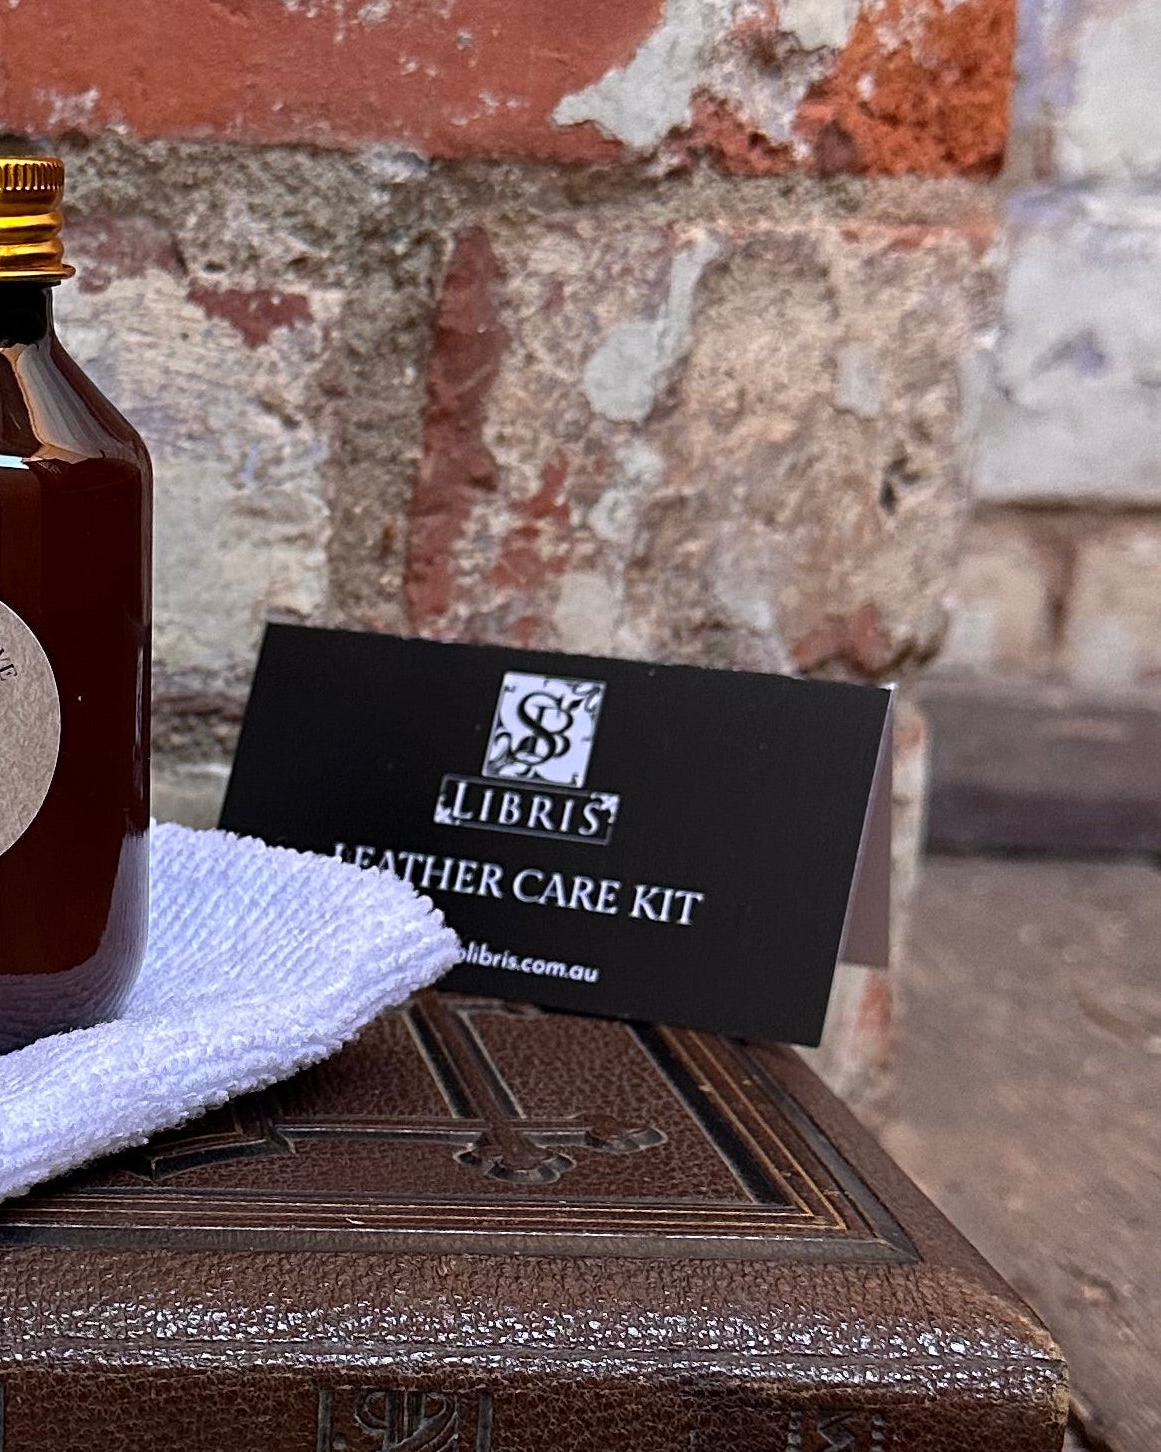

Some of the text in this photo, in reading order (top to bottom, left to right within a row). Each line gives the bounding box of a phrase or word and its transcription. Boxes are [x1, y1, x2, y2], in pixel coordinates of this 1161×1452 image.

[452, 781, 603, 836] LIBRIS
[512, 868, 622, 915] CARE
[628, 883, 705, 926] KIT
